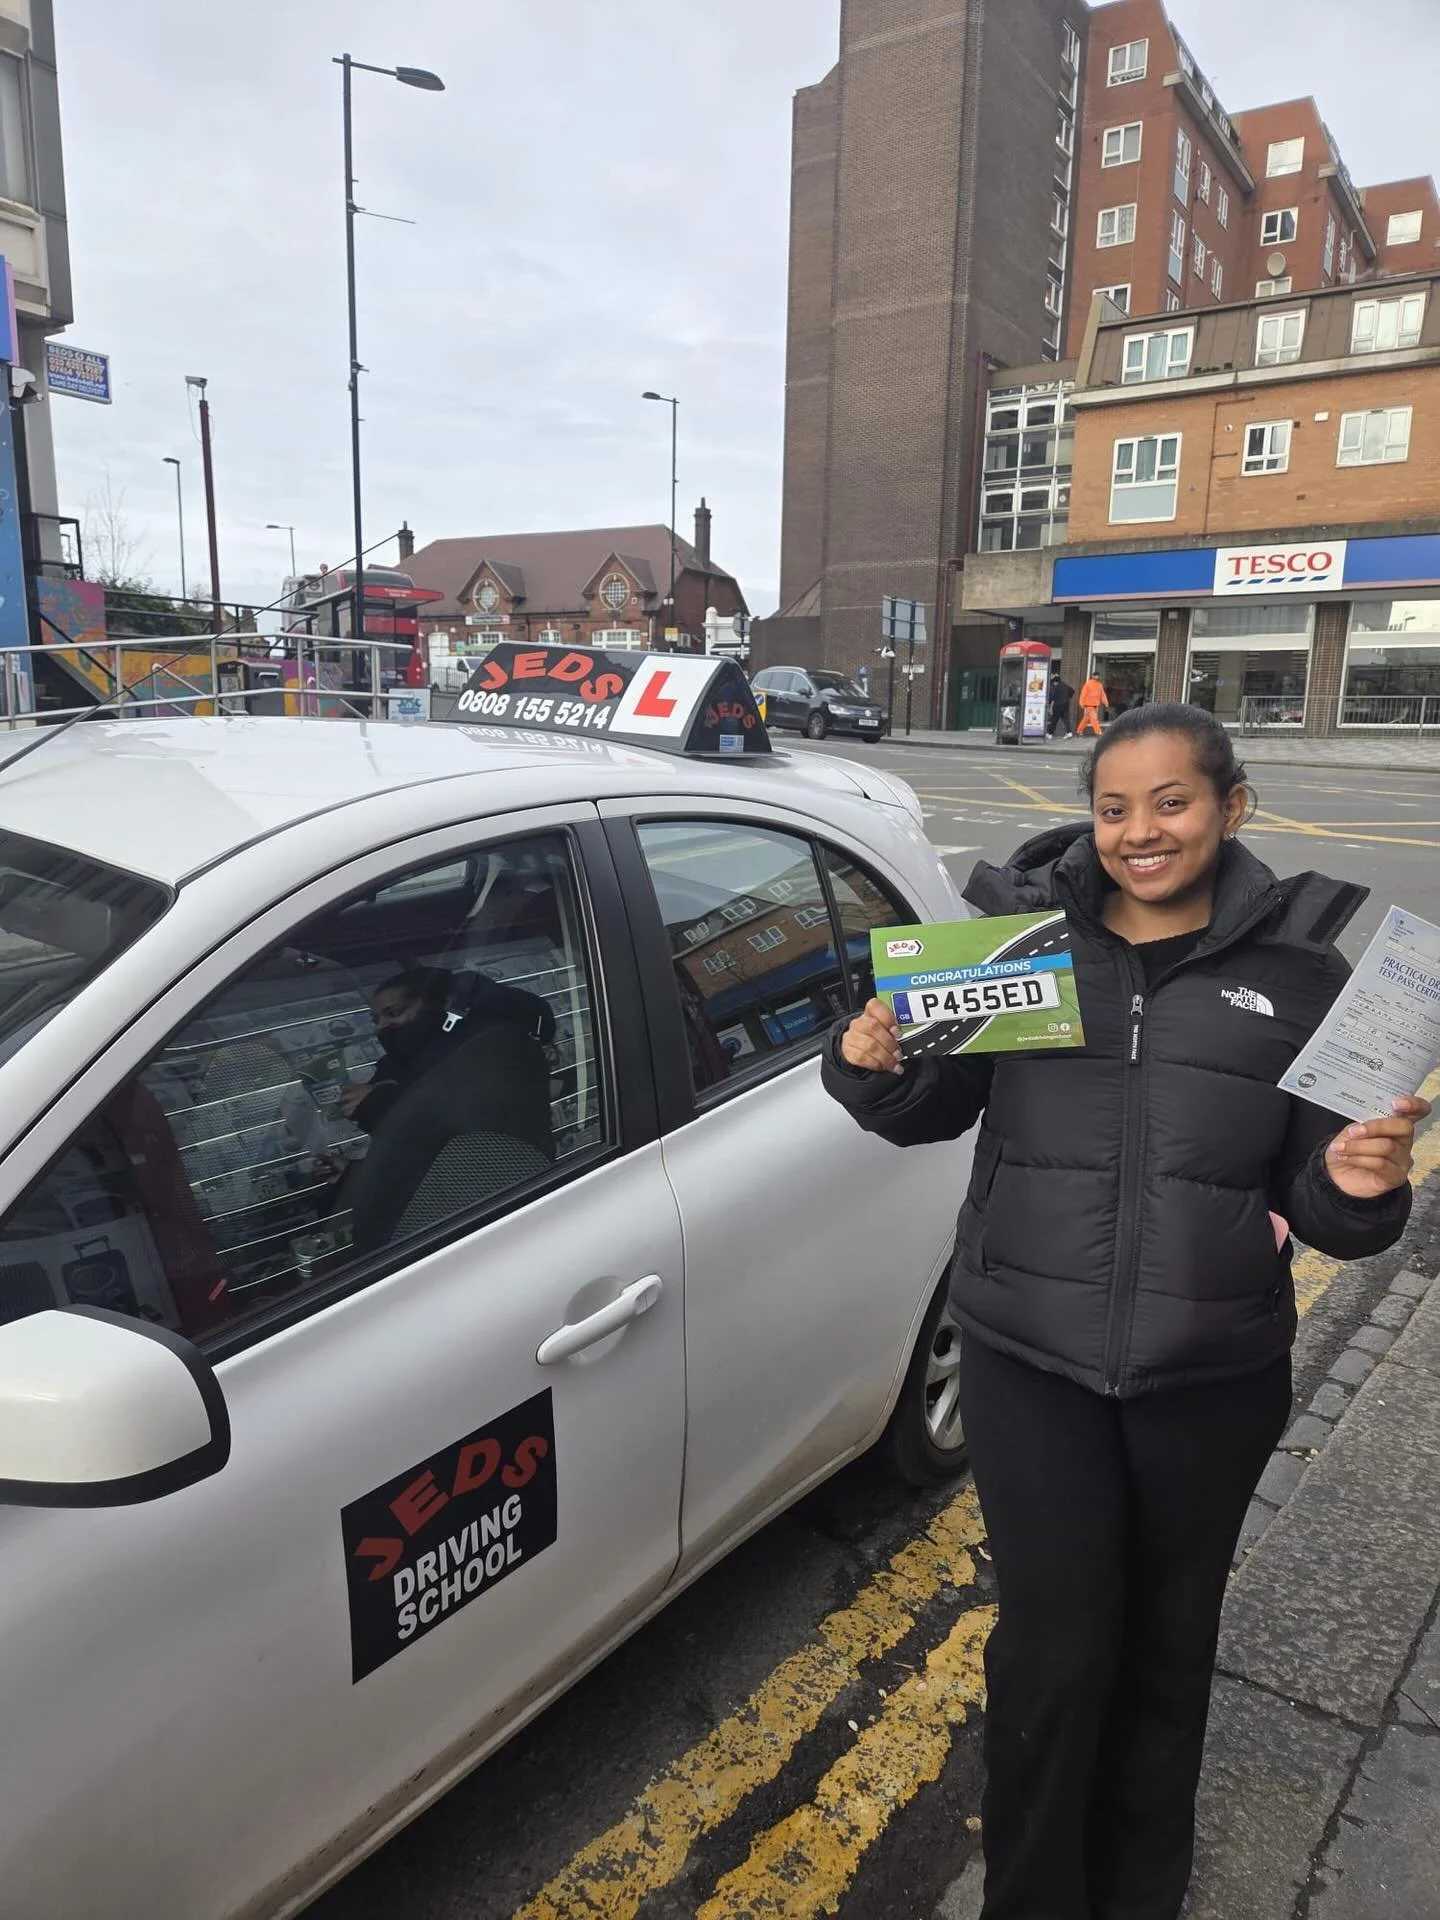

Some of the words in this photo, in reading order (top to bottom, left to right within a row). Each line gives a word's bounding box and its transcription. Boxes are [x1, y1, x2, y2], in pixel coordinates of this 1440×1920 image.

[1227, 551, 1333, 576] TESCO
[479, 651, 624, 704] JEDS
[632, 670, 678, 718] L
[458, 689, 511, 717] 0808
[513, 696, 553, 722] 155
[553, 701, 612, 730] 5214
[704, 700, 757, 730] JEDS
[889, 942, 916, 953] JEDS
[910, 960, 1032, 986] CONGRATULATIONS
[1379, 966, 1398, 980] TEST
[1396, 975, 1416, 990] PASS
[1383, 956, 1427, 984] PRACTICAL
[921, 979, 1044, 1018] P455ED
[1221, 989, 1256, 1005] NORTH
[1230, 999, 1257, 1012] FACE
[1237, 986, 1256, 998] THE
[899, 1013, 911, 1021] GB
[354, 1435, 549, 1582] JEDS
[393, 1493, 522, 1607] DRIVING
[397, 1533, 522, 1640] SCHOOL
